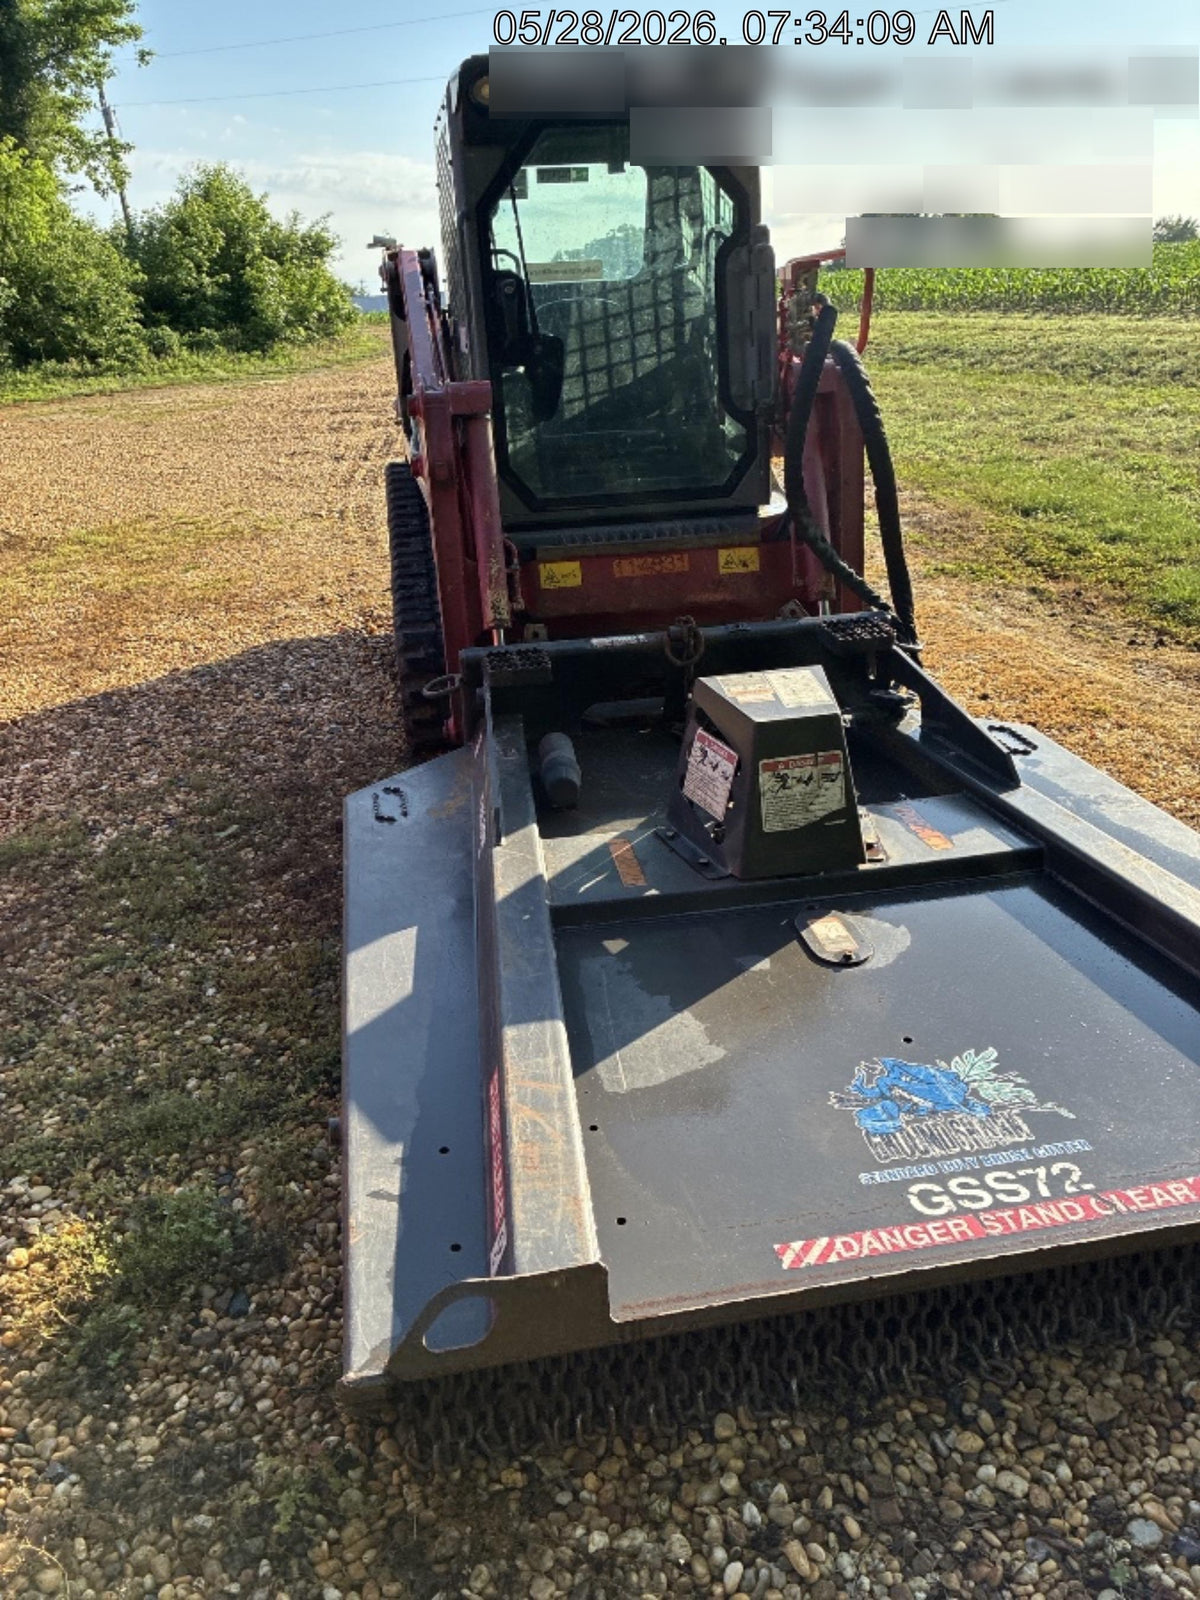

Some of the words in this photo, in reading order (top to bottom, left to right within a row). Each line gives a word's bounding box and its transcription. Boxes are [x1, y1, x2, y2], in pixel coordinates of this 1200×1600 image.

[835, 1218, 975, 1257] DANGER
[979, 1199, 1086, 1235] STAND
[1090, 1181, 1198, 1215] CLEAR
[907, 1162, 1096, 1216] GSS72
